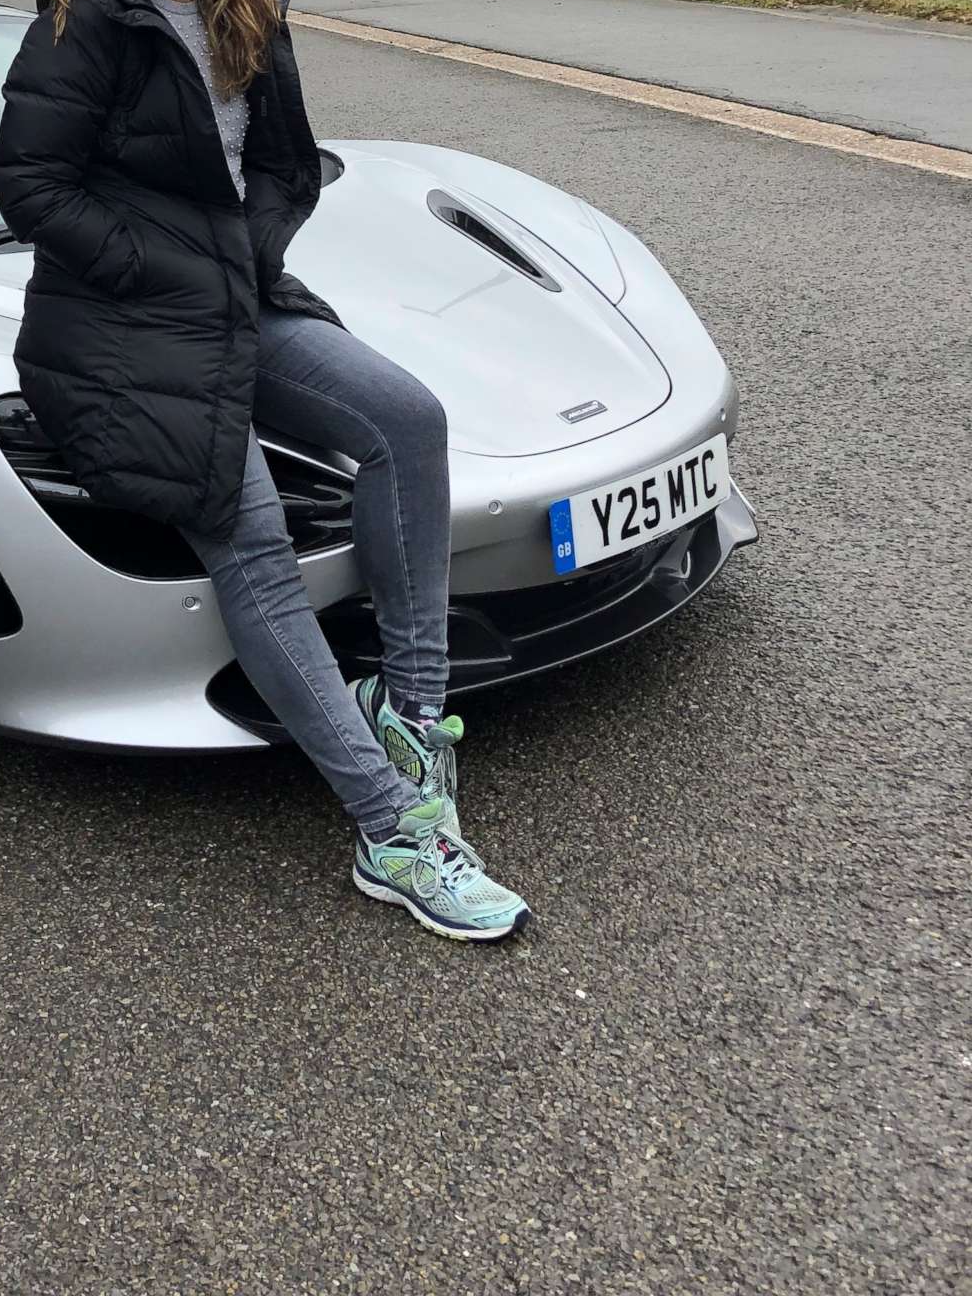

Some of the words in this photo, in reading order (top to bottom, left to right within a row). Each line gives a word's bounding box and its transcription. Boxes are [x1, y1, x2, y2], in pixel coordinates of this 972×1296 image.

[591, 477, 660, 547] Y25
[667, 449, 717, 518] MTC
[557, 541, 572, 558] GB
